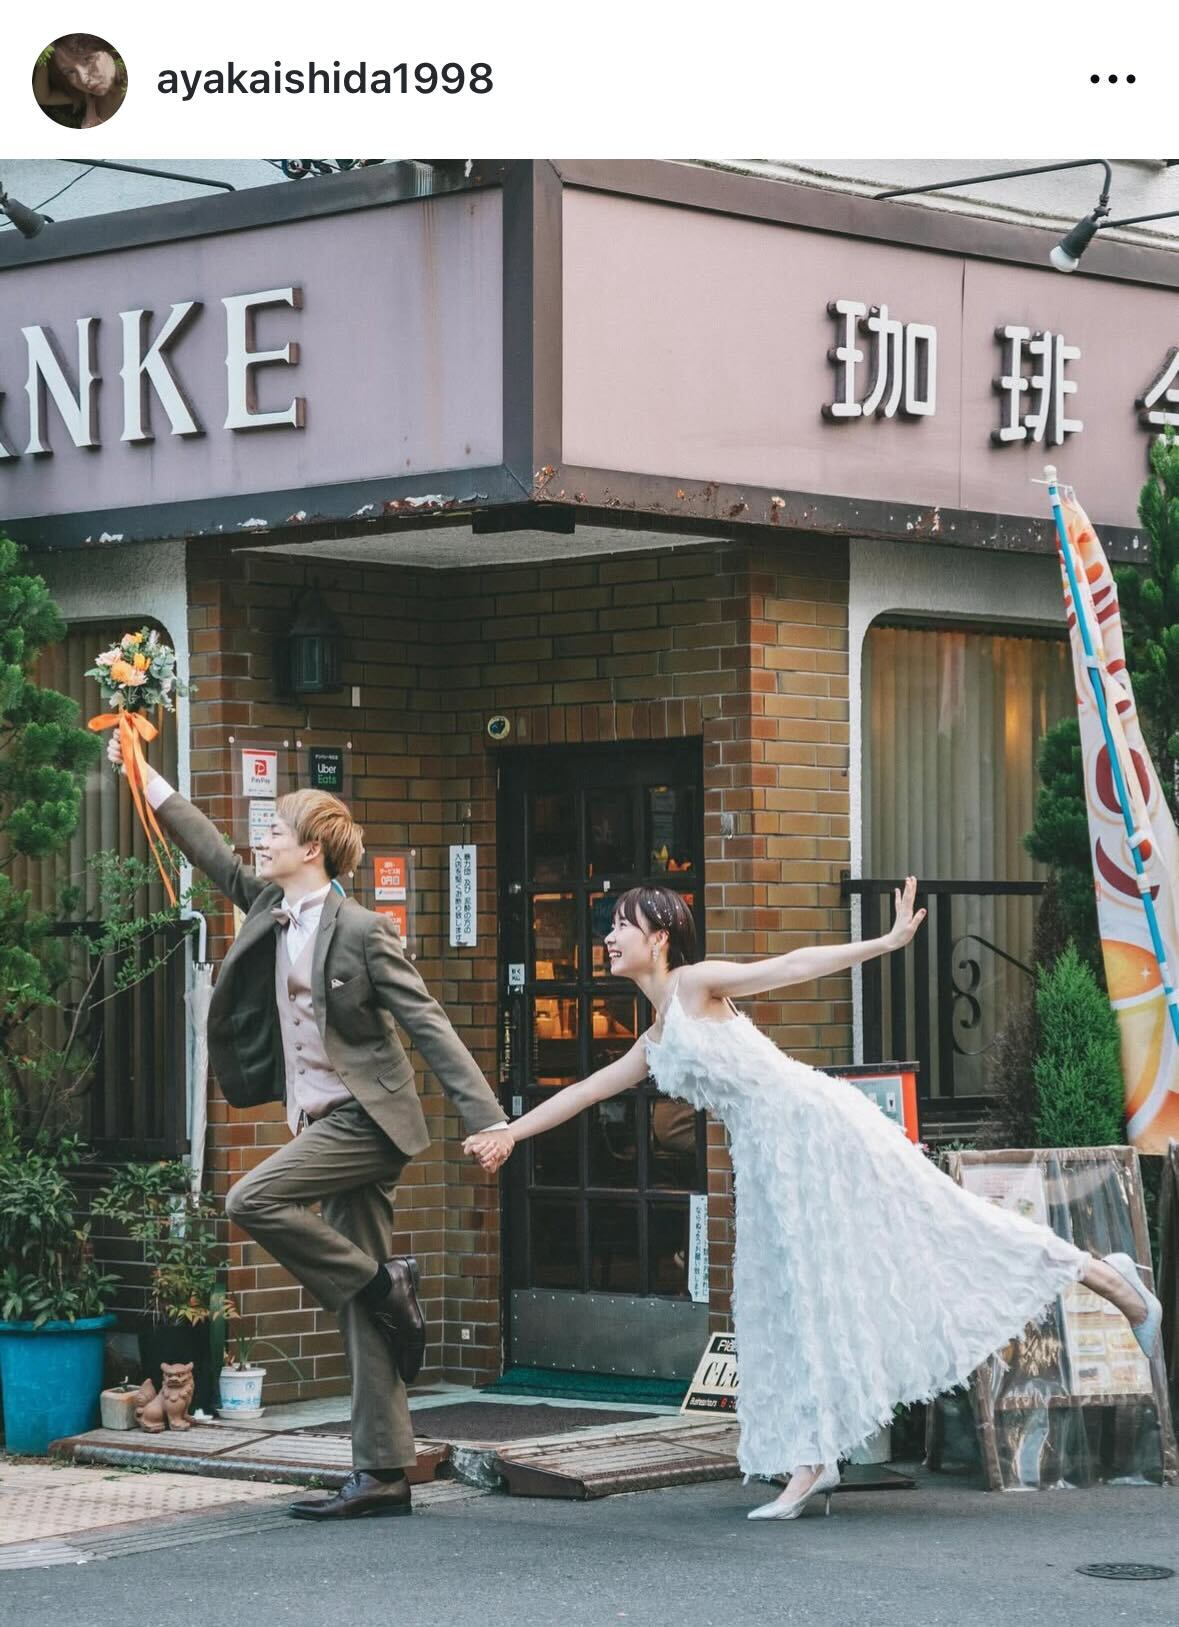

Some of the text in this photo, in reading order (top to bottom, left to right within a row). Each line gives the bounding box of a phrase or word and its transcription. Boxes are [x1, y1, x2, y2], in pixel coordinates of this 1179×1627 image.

[0, 287, 305, 459] NKE
[317, 763, 336, 774] Uber
[318, 774, 337, 784] Eats
